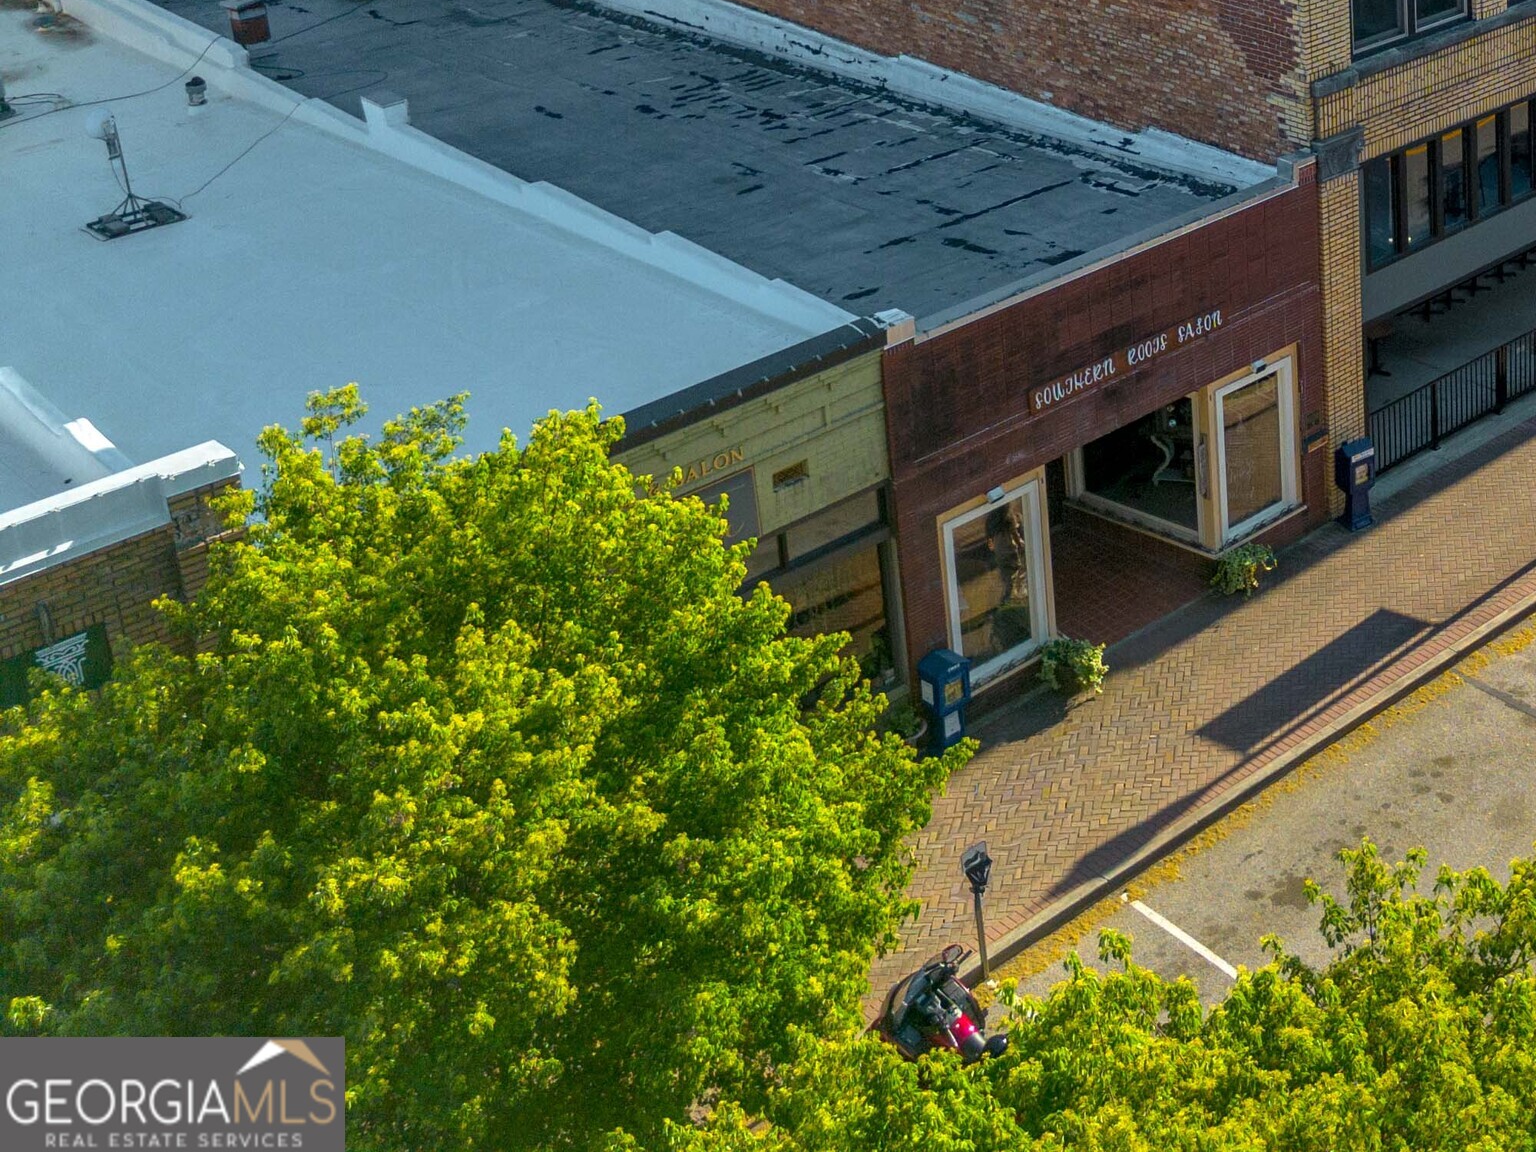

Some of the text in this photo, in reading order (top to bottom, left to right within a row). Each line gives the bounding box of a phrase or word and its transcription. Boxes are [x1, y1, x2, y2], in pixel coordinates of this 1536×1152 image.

[1035, 309, 1223, 409] SOUTHERN ROOTS SALON
[676, 446, 744, 486] ALON
